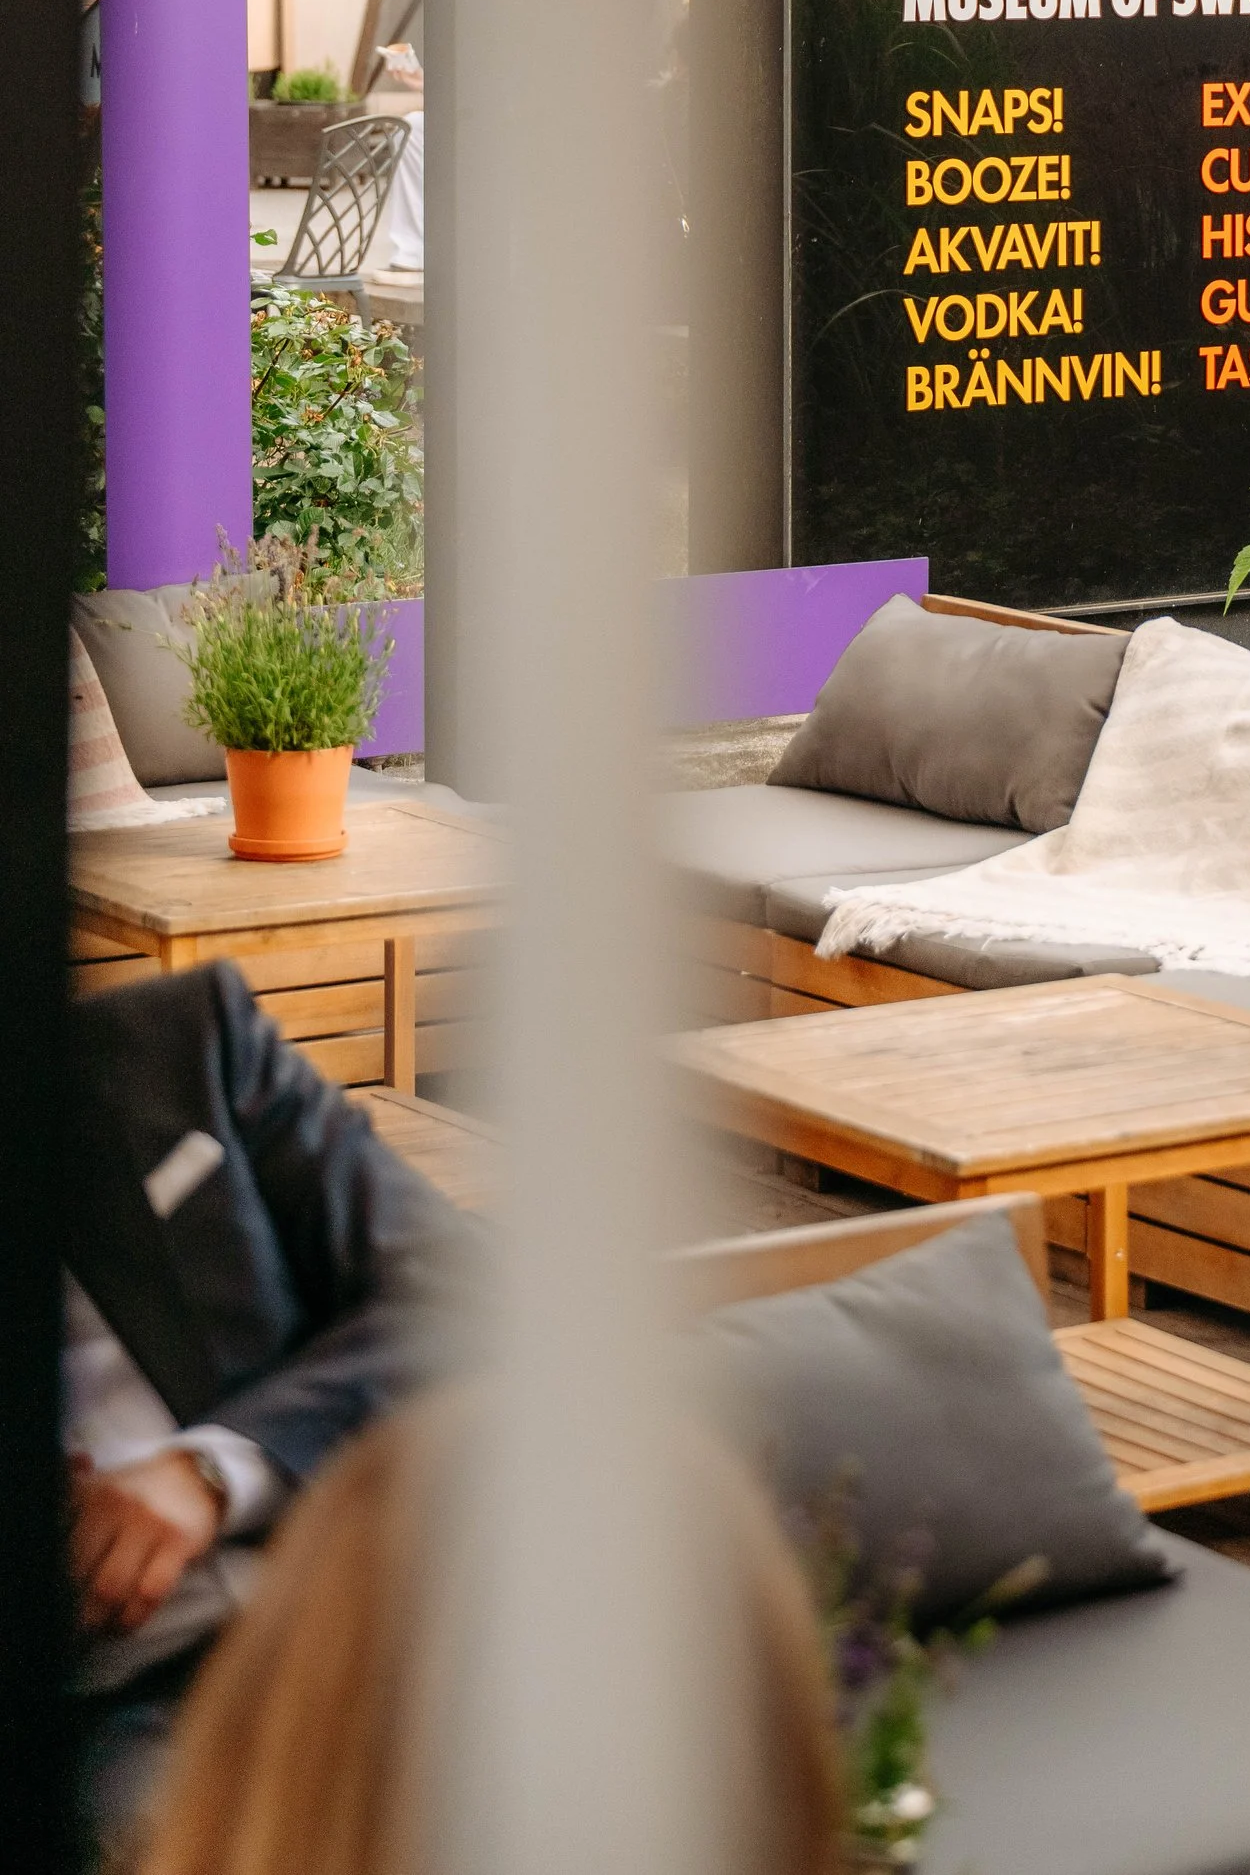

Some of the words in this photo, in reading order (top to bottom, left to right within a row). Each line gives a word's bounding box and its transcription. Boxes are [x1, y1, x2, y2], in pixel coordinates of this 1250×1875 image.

[904, 87, 1064, 138] SNAPS!
[906, 154, 1071, 206] BOOZE!
[903, 220, 1101, 275] AKVAVIT!
[903, 288, 1083, 344] VODKA!
[907, 347, 1162, 412] BRÄNNVIN!
